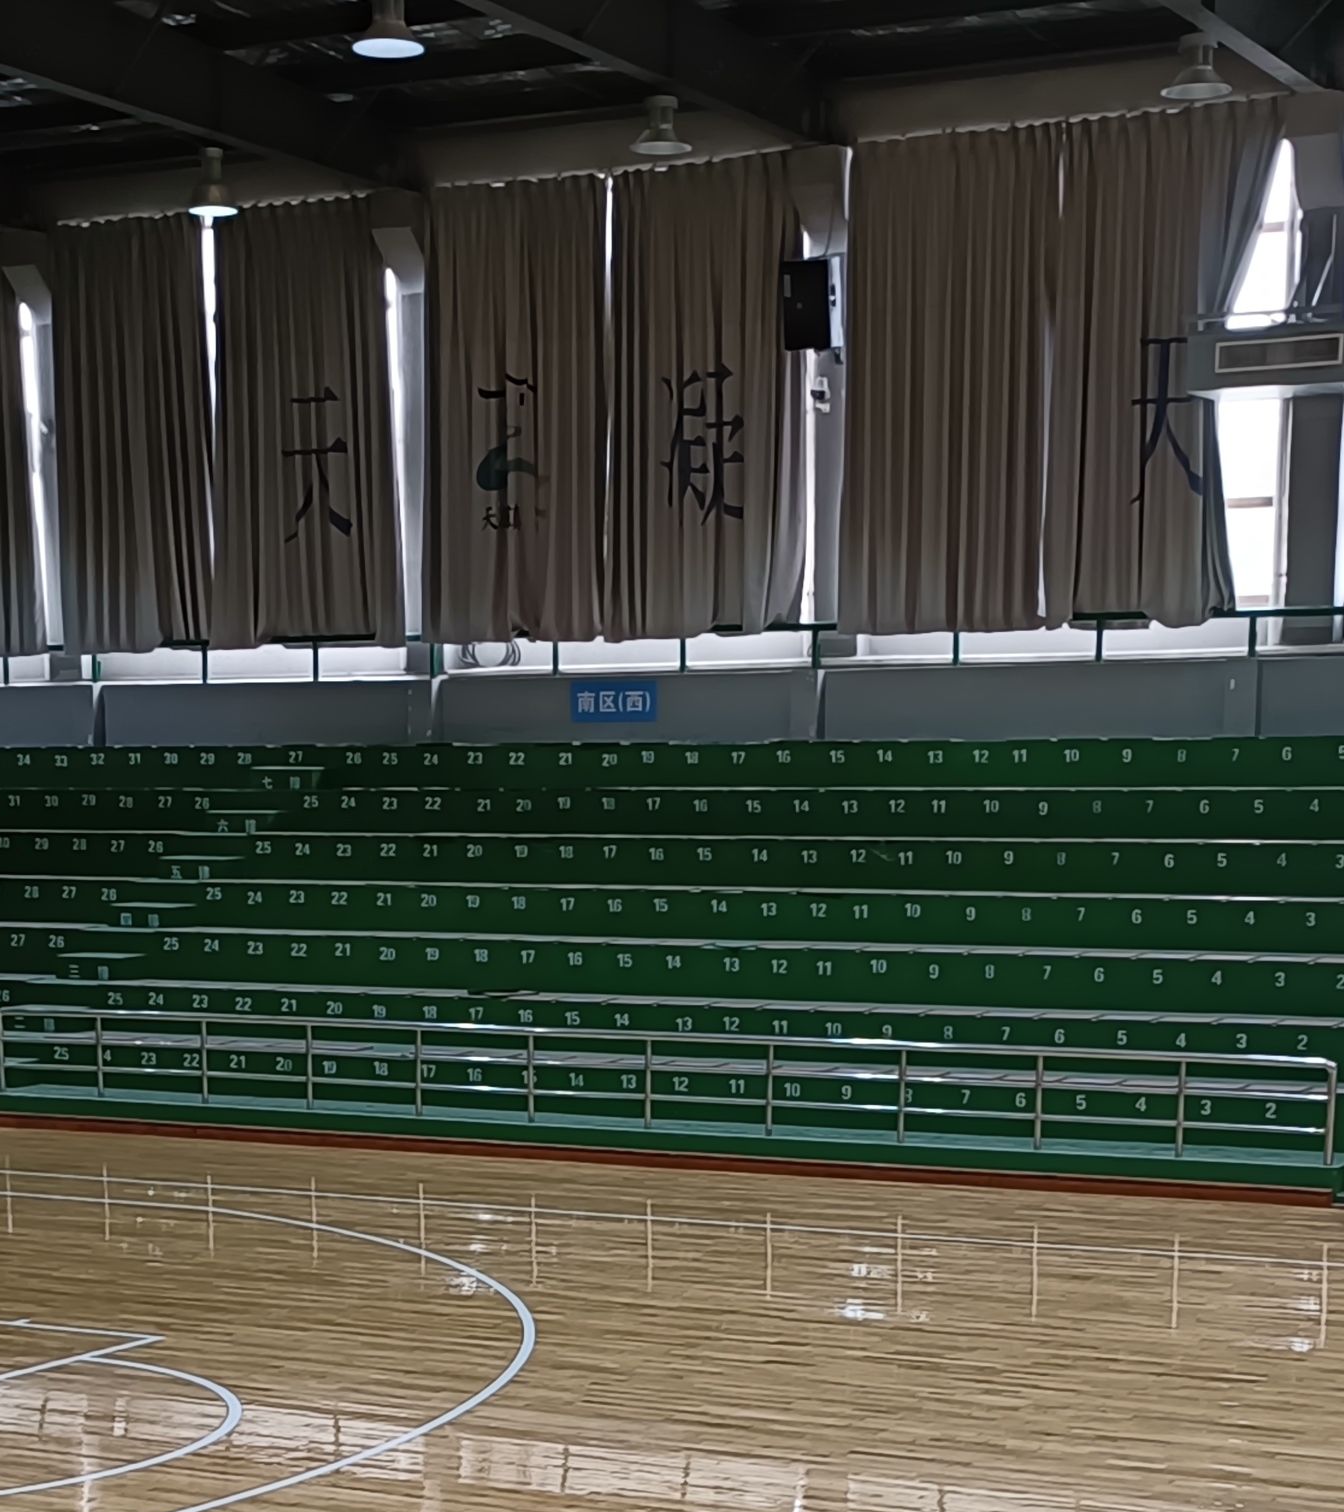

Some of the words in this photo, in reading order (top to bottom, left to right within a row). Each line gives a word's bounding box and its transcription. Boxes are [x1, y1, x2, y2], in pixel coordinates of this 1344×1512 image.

[282, 386, 352, 543] 天
[575, 690, 652, 714] 南区(西)
[127, 752, 142, 766] 31
[423, 752, 439, 766] 24
[508, 751, 526, 766] 22
[828, 749, 846, 764] 15
[876, 748, 894, 764] 14
[926, 749, 944, 765] 13
[1121, 747, 1133, 764] 9
[1281, 745, 1293, 762] 6
[302, 794, 320, 809] 25
[423, 795, 443, 811] 22
[744, 798, 762, 814] 15
[841, 799, 859, 815] 13
[1037, 800, 1049, 817] 9
[1198, 798, 1210, 815] 6
[1308, 797, 1320, 813] 4
[255, 840, 272, 855] 25
[294, 842, 311, 856] 24
[335, 842, 352, 857] 23
[422, 843, 438, 858] 21
[696, 846, 713, 862] 15
[849, 848, 867, 864] 12
[1003, 849, 1015, 866] 9
[1163, 852, 1175, 869] 6
[205, 886, 223, 901] 25
[246, 890, 263, 906] 24
[330, 890, 349, 906] 22
[375, 891, 392, 907] 21
[559, 896, 576, 912] 17
[710, 898, 728, 914] 14
[809, 902, 828, 918] 12
[965, 905, 977, 922] 9
[1130, 908, 1143, 925] 6
[1243, 910, 1256, 926] 4
[162, 936, 180, 951] 25
[203, 937, 220, 953] 24
[290, 942, 308, 958] 22
[519, 949, 536, 965] 17
[722, 956, 741, 973] 13
[928, 963, 940, 980] 9
[1093, 966, 1105, 983] 6
[1152, 968, 1164, 985] 5
[1210, 969, 1223, 986] 4
[147, 991, 165, 1006] 24
[234, 996, 253, 1012] 22
[722, 1015, 741, 1032] 12
[1053, 1028, 1066, 1045] 6
[1116, 1029, 1128, 1046] 5
[1296, 1033, 1309, 1051] 2
[52, 1045, 70, 1061] 25
[228, 1053, 247, 1070] 21
[619, 1073, 638, 1090] 13
[728, 1078, 746, 1095] 11
[960, 1088, 972, 1105] 7
[1075, 1093, 1088, 1111] 5
[1264, 1101, 1278, 1120] 2
